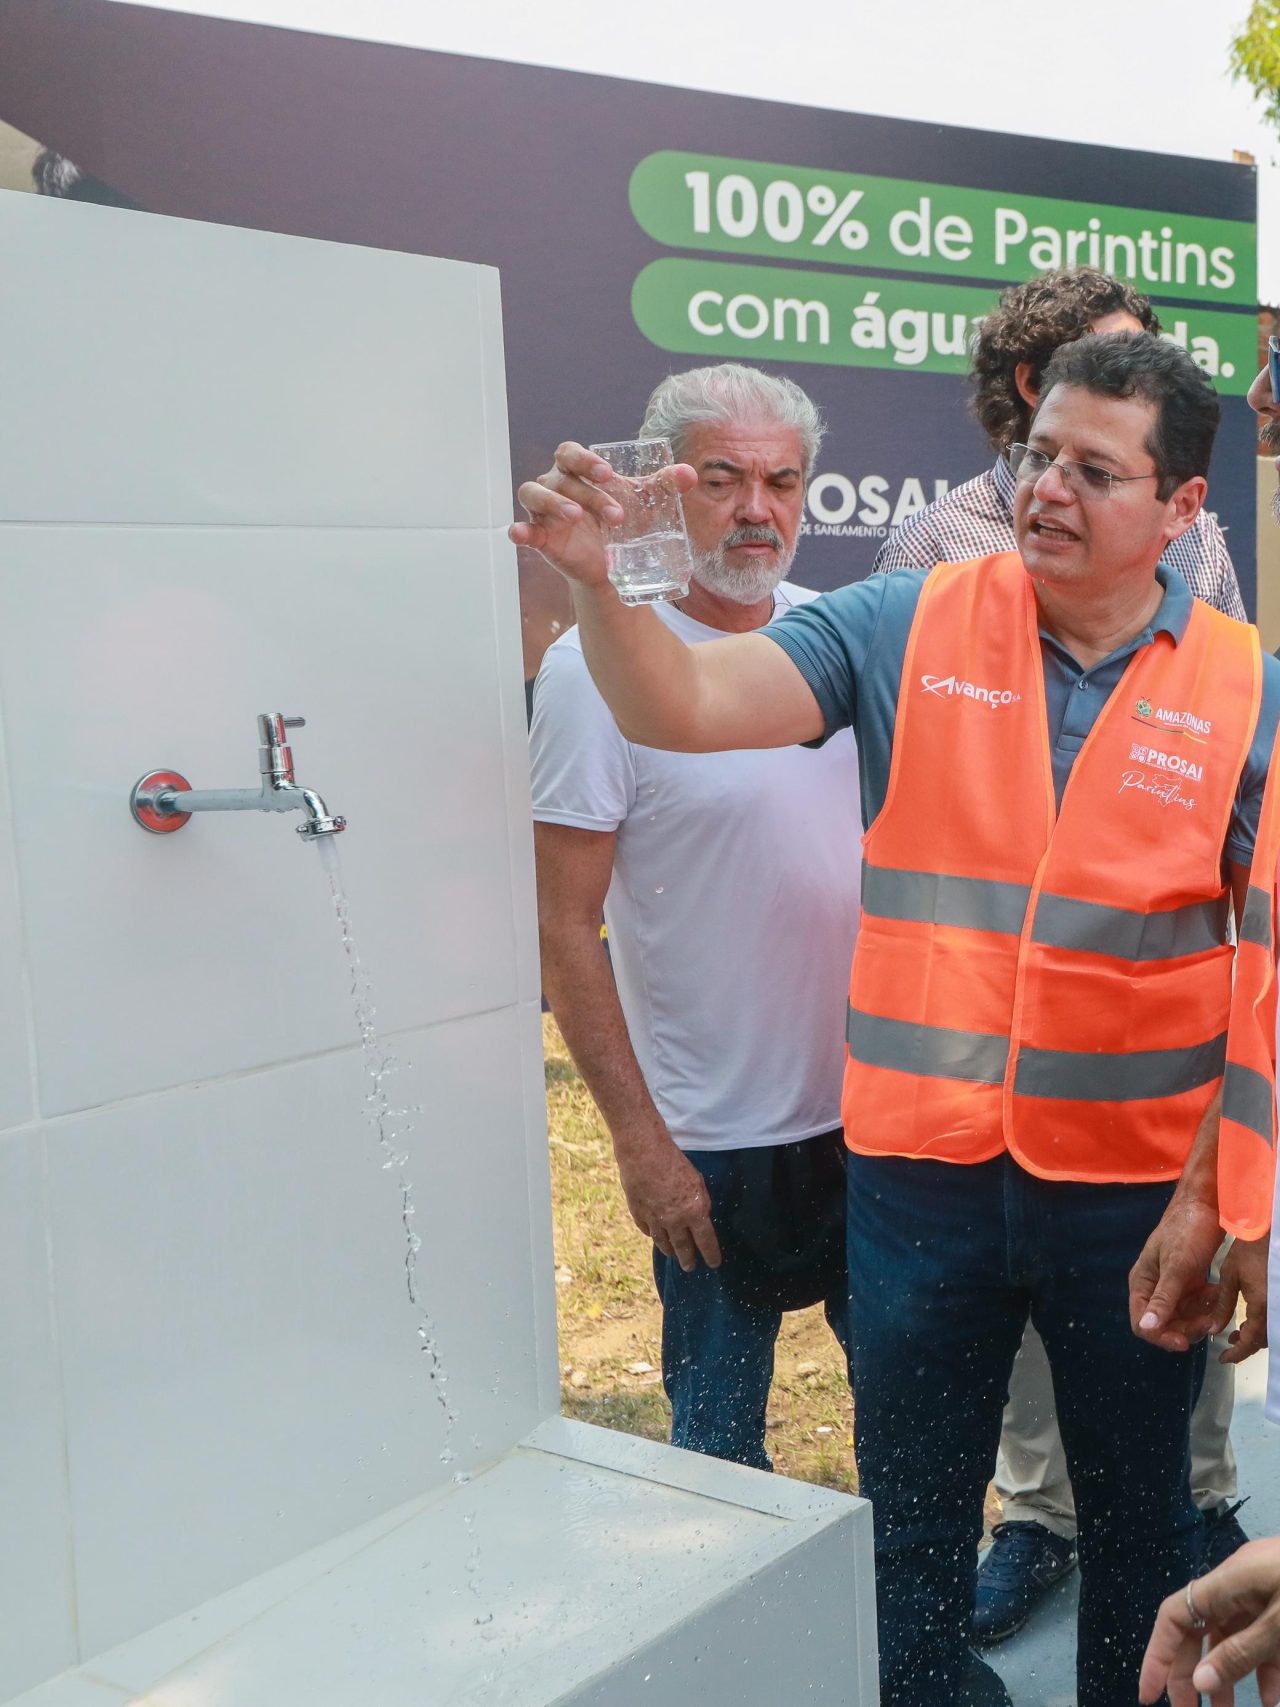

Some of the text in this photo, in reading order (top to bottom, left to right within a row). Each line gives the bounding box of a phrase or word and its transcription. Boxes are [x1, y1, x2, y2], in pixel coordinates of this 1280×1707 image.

[684, 170, 1236, 289] 100% de Parintins
[687, 290, 988, 366] com águ
[814, 524, 887, 538] SANEAMENTO
[920, 675, 1013, 709] Avanço
[1154, 707, 1212, 734] AMAZONAS
[1146, 748, 1203, 779] PROSAI
[1118, 770, 1198, 810] Parintins
